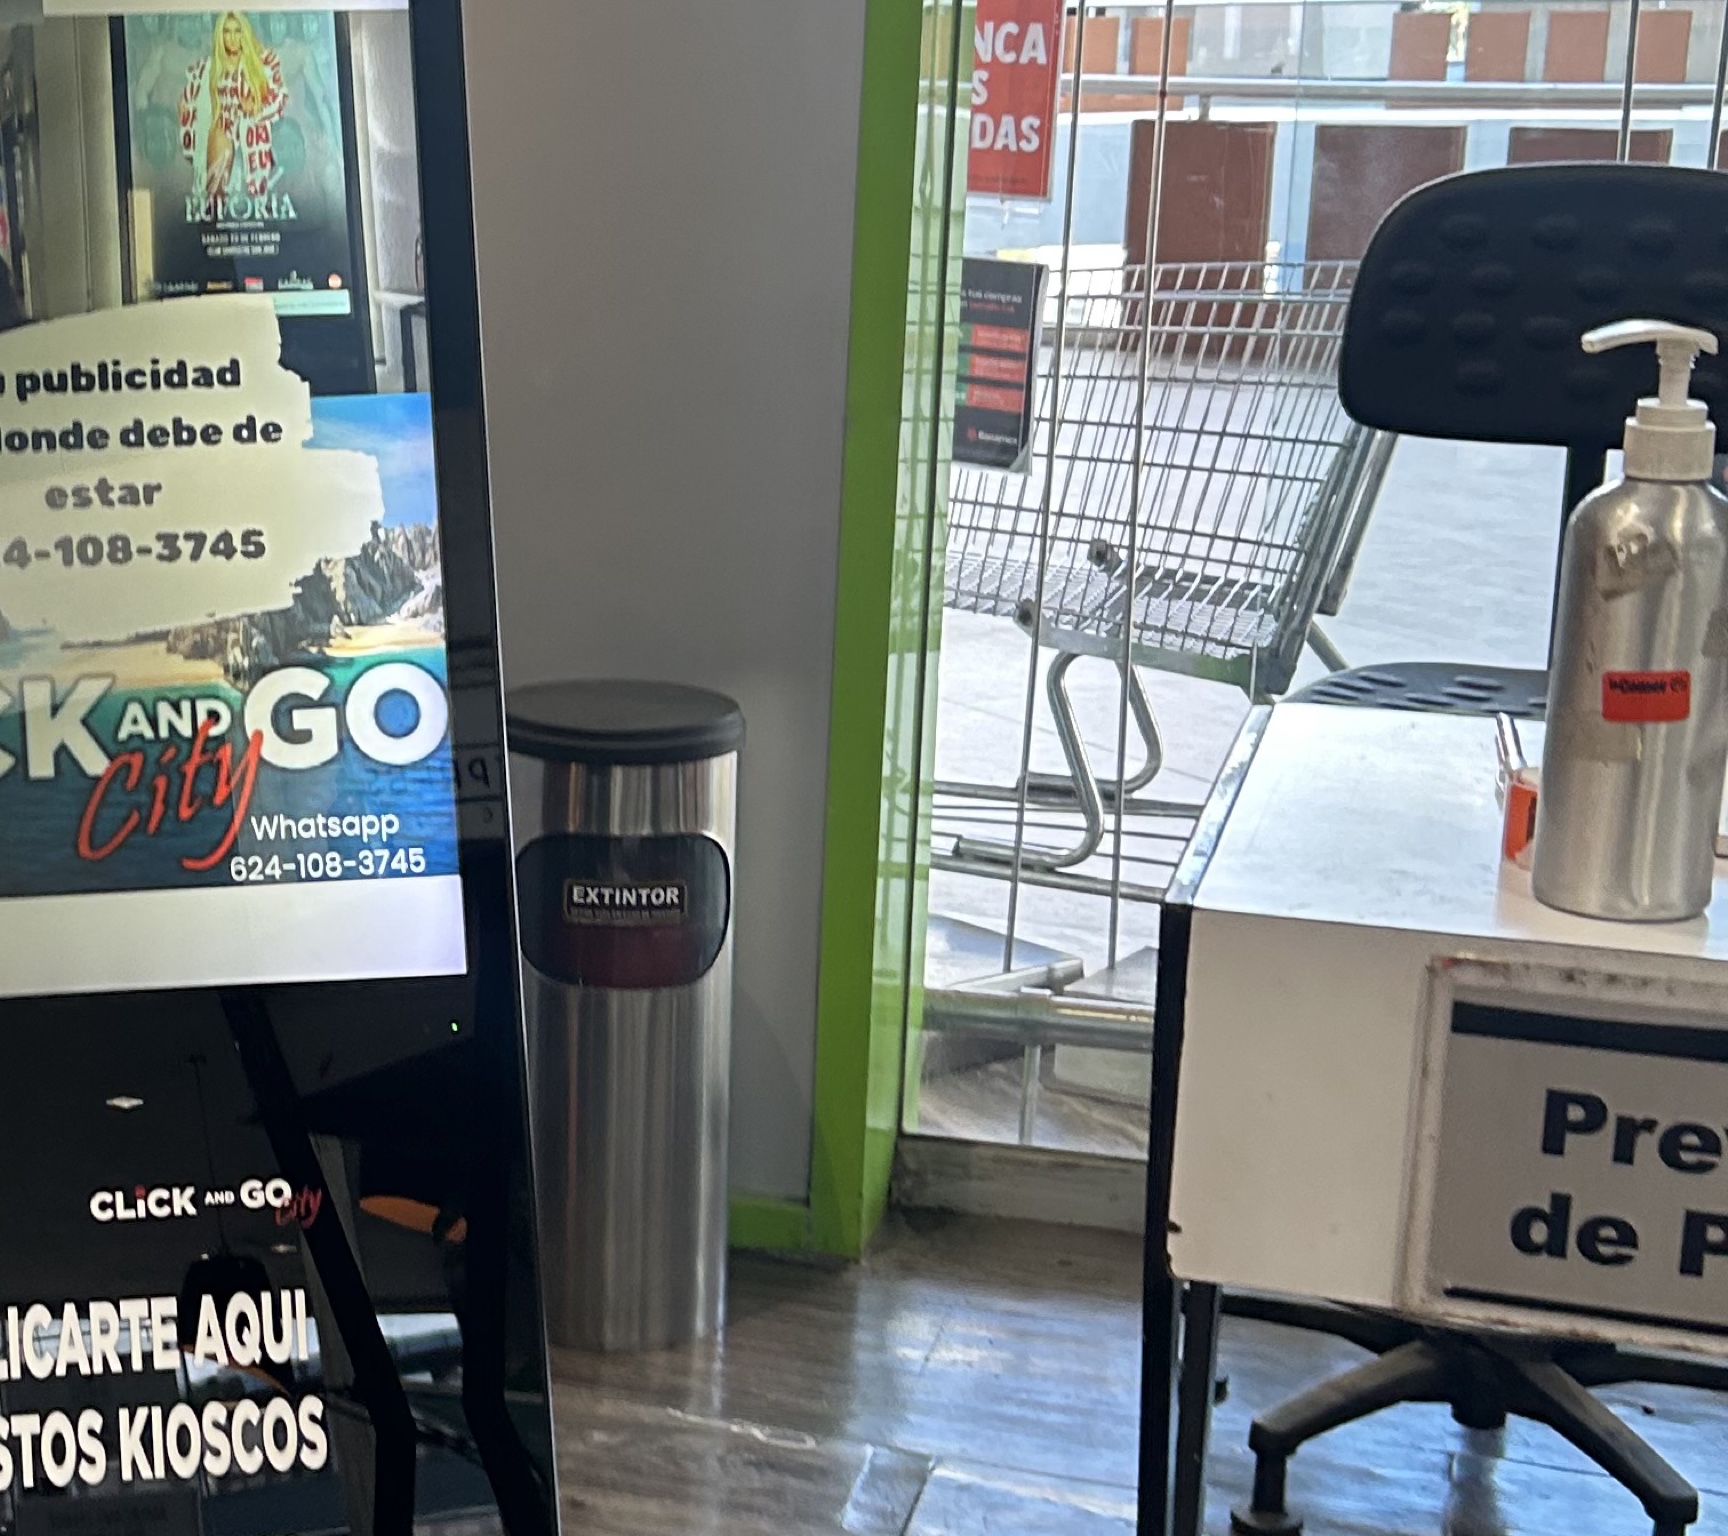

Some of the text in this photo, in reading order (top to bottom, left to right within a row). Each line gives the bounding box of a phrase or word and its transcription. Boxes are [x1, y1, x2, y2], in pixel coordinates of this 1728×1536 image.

[974, 21, 1047, 65] NCA
[971, 115, 1040, 152] DAS
[15, 358, 242, 399] publicidad
[119, 415, 222, 450] debe
[232, 414, 284, 445] de
[44, 478, 163, 511] estar
[117, 696, 230, 742] AND
[244, 664, 449, 772] GO
[78, 717, 266, 872] City
[250, 810, 400, 845] Whatsapp
[229, 847, 427, 883] 624-108-3745
[572, 884, 680, 906] EXTINTOR
[1542, 1088, 1728, 1174] Pre
[204, 1190, 235, 1207] AND
[239, 1179, 292, 1211] GO
[1510, 1191, 1728, 1278] de P
[194, 1288, 308, 1368] AQUI
[119, 1396, 328, 1483] KIOSCOS
